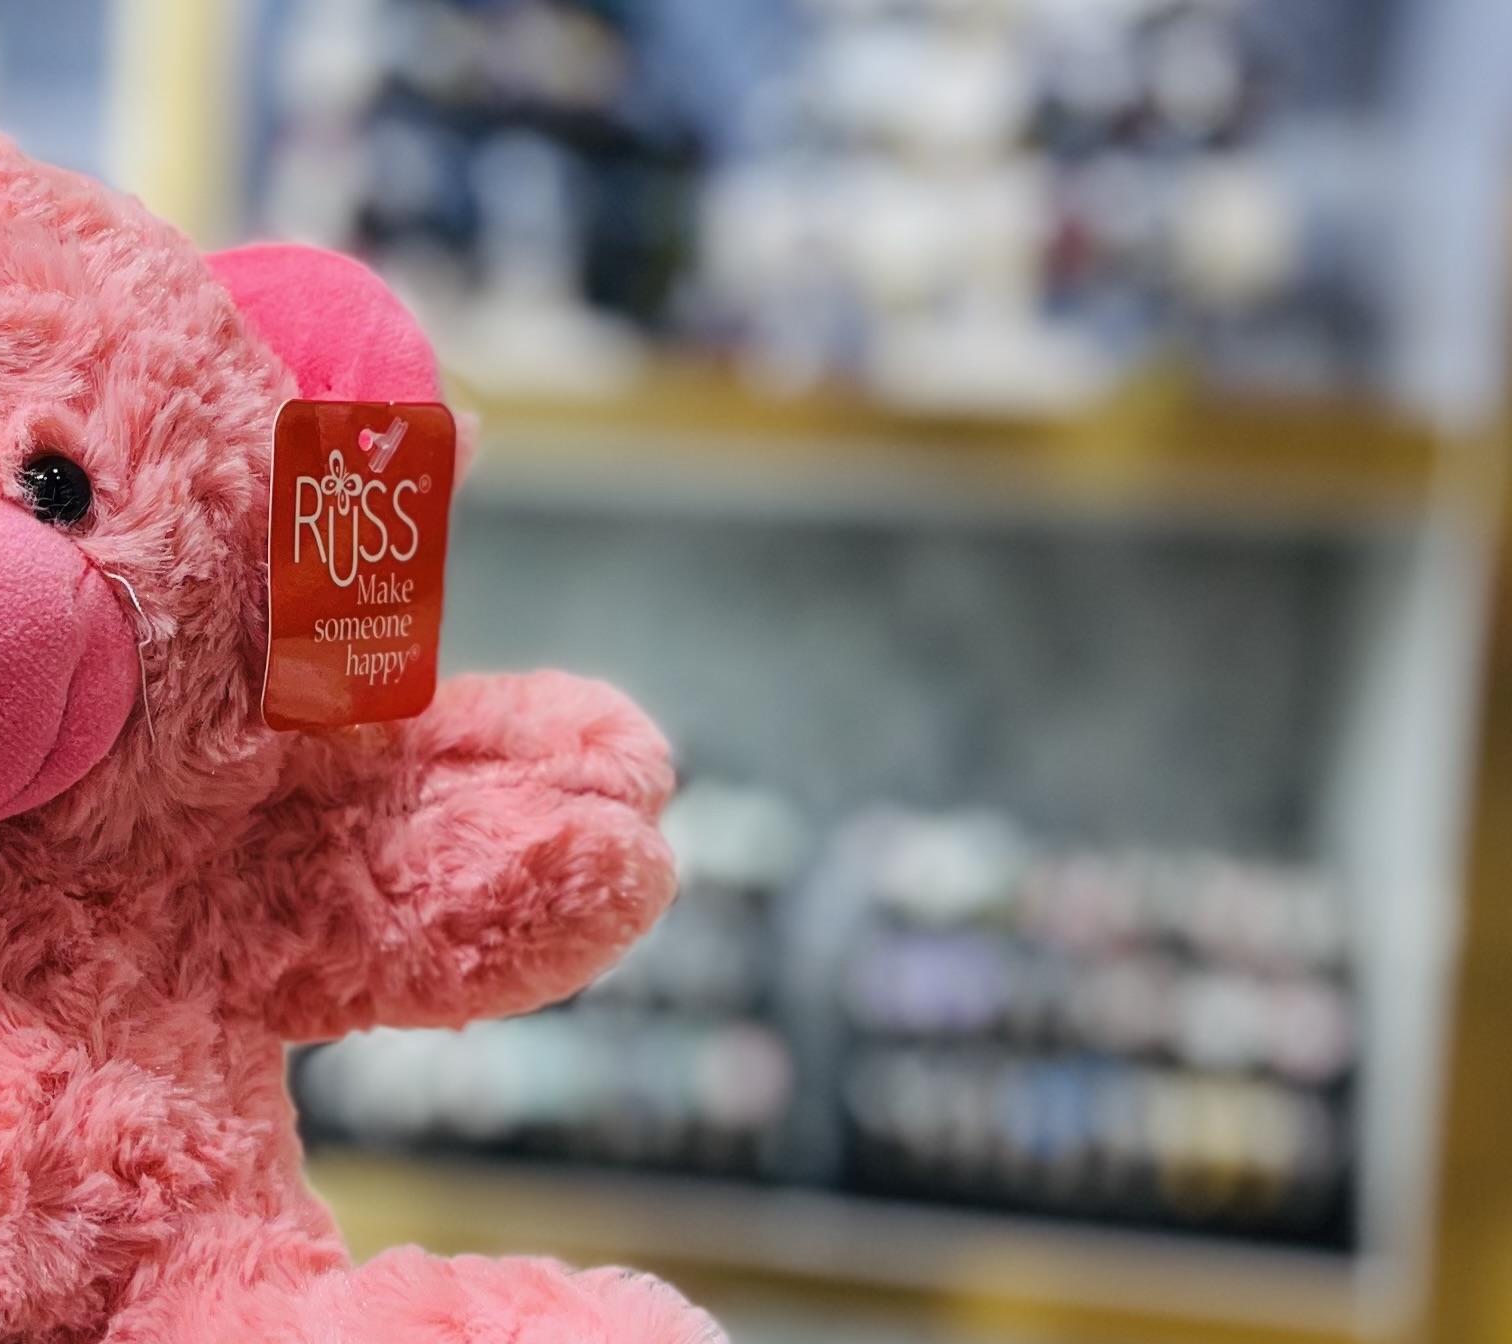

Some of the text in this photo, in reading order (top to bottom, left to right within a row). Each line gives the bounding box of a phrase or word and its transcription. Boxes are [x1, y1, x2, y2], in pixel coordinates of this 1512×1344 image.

[294, 475, 419, 587] RUSS
[356, 573, 414, 605] Make
[314, 613, 413, 643] someone
